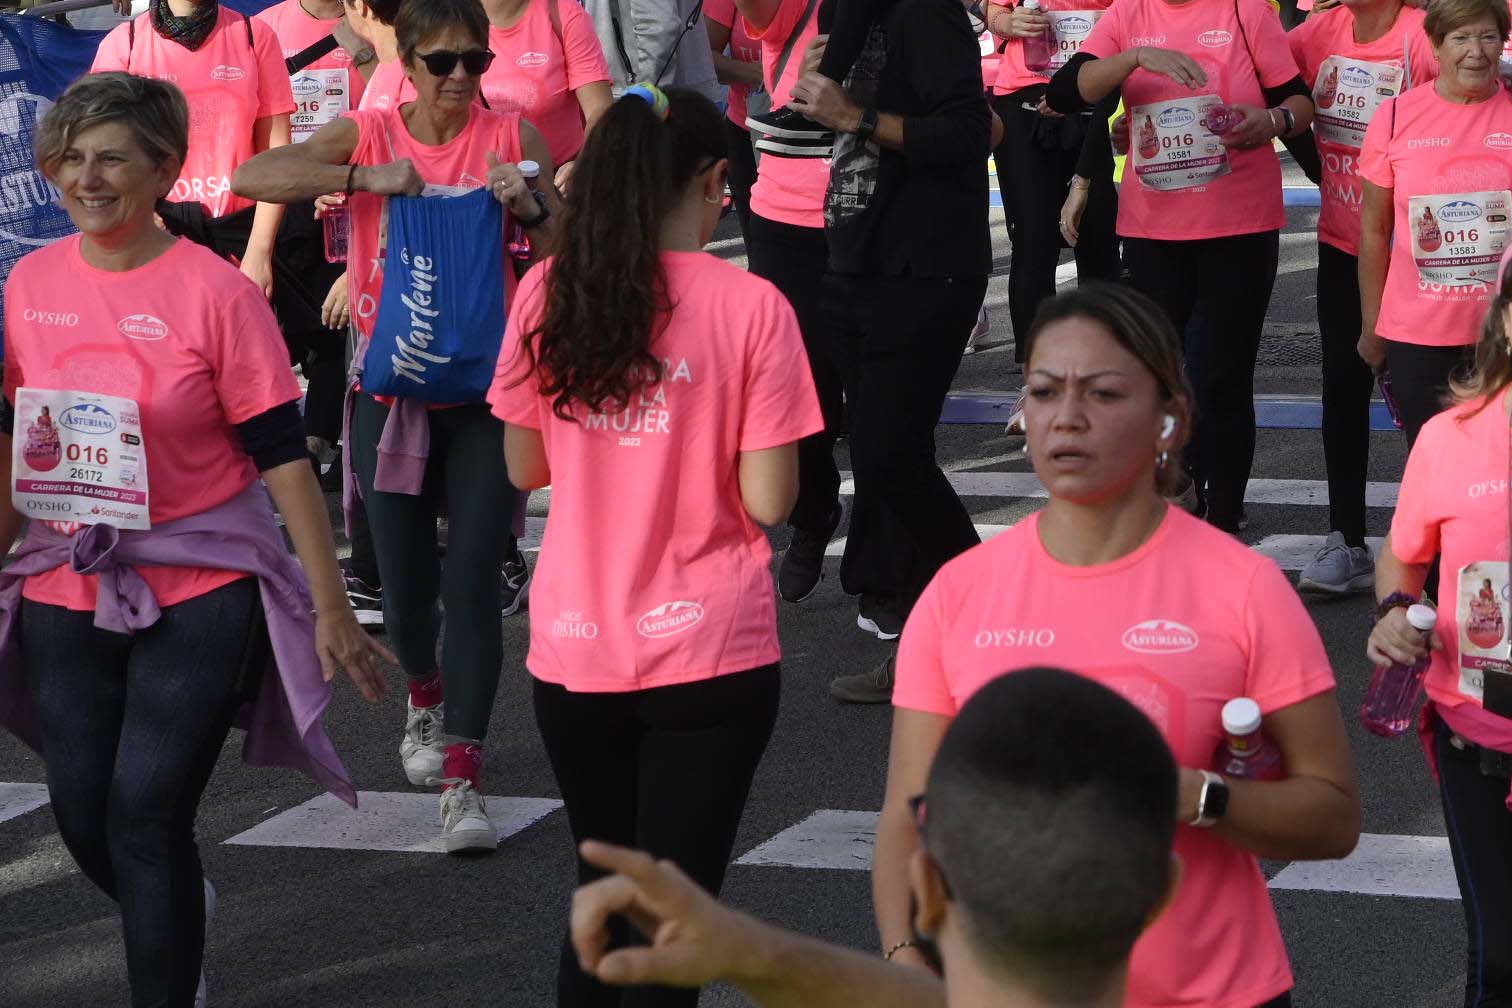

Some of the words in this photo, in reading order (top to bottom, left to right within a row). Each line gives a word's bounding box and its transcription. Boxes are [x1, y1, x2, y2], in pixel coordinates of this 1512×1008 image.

[1336, 92, 1366, 109] 016
[1159, 113, 1195, 126] ASTURIANA
[1337, 108, 1360, 120] 13582
[1162, 134, 1194, 149] 016
[1407, 137, 1450, 150] OYSHO
[1167, 150, 1192, 161] 13581
[1441, 209, 1480, 218] ASTURIANA
[1444, 229, 1479, 244] 016
[1449, 246, 1476, 256] 13583
[23, 309, 79, 327] OYSHO
[639, 384, 667, 408] LA
[63, 413, 115, 432] ASTURIANA
[586, 410, 671, 433] MUJER
[618, 436, 641, 447] 2023
[66, 443, 109, 465] 016
[70, 468, 103, 482] 26172
[31, 483, 72, 494] CARRERA
[73, 486, 83, 494] DE
[84, 488, 94, 496] LA
[94, 489, 119, 499] MUJER
[27, 499, 72, 514] OYSHO
[101, 506, 139, 521] Santander
[642, 609, 701, 633] ASTURIANA
[974, 629, 1055, 649] OYSHO
[1129, 631, 1193, 647] ASTURIANA
